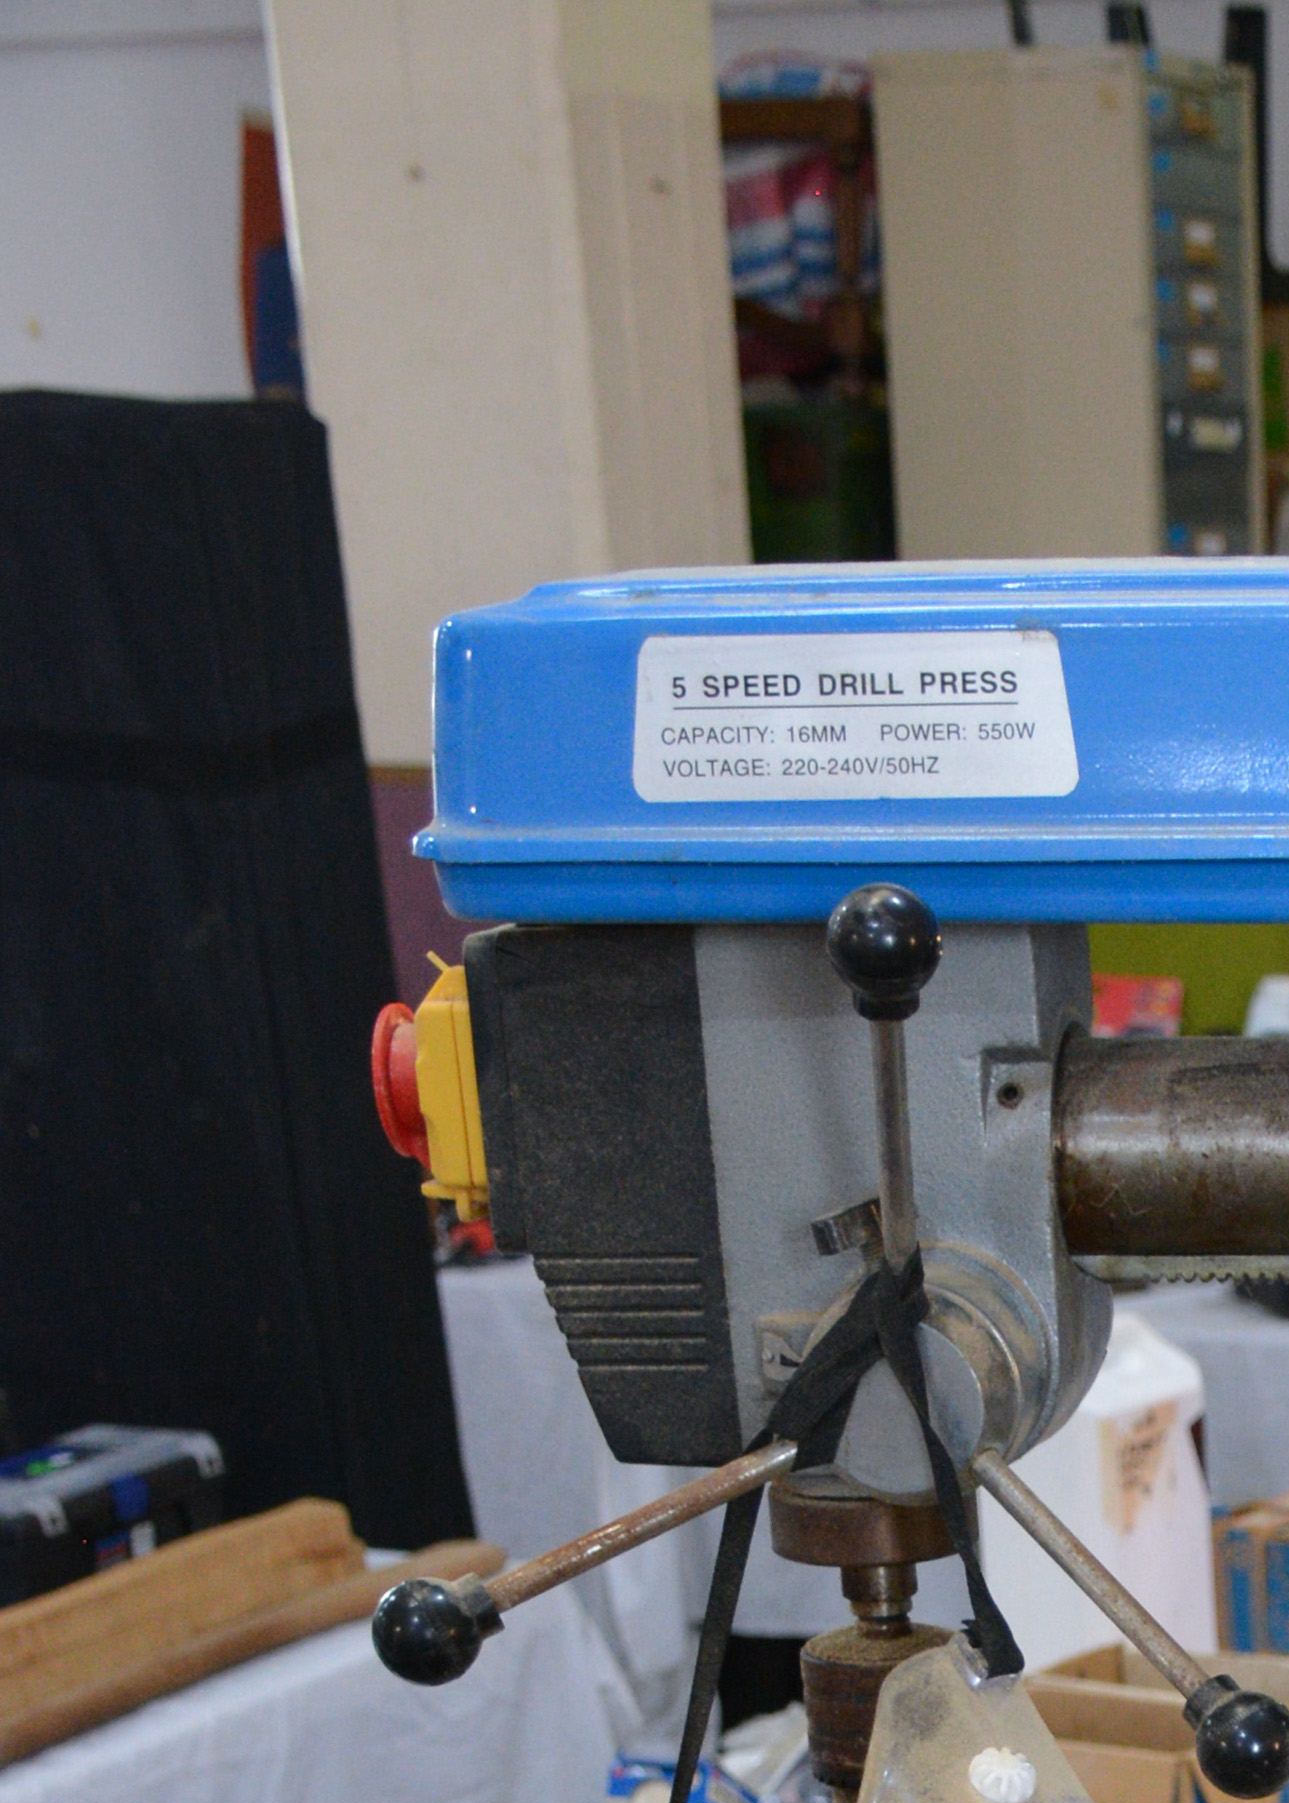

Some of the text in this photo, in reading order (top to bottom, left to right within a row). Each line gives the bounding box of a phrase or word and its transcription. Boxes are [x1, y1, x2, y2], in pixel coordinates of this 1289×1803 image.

[672, 670, 1019, 698] 5 SPEED DRILL PRESS
[661, 721, 1036, 746] CAPACITY: 16MM POWER: 550W
[663, 755, 940, 778] VOLTAGE: 220-240V/50HZ
